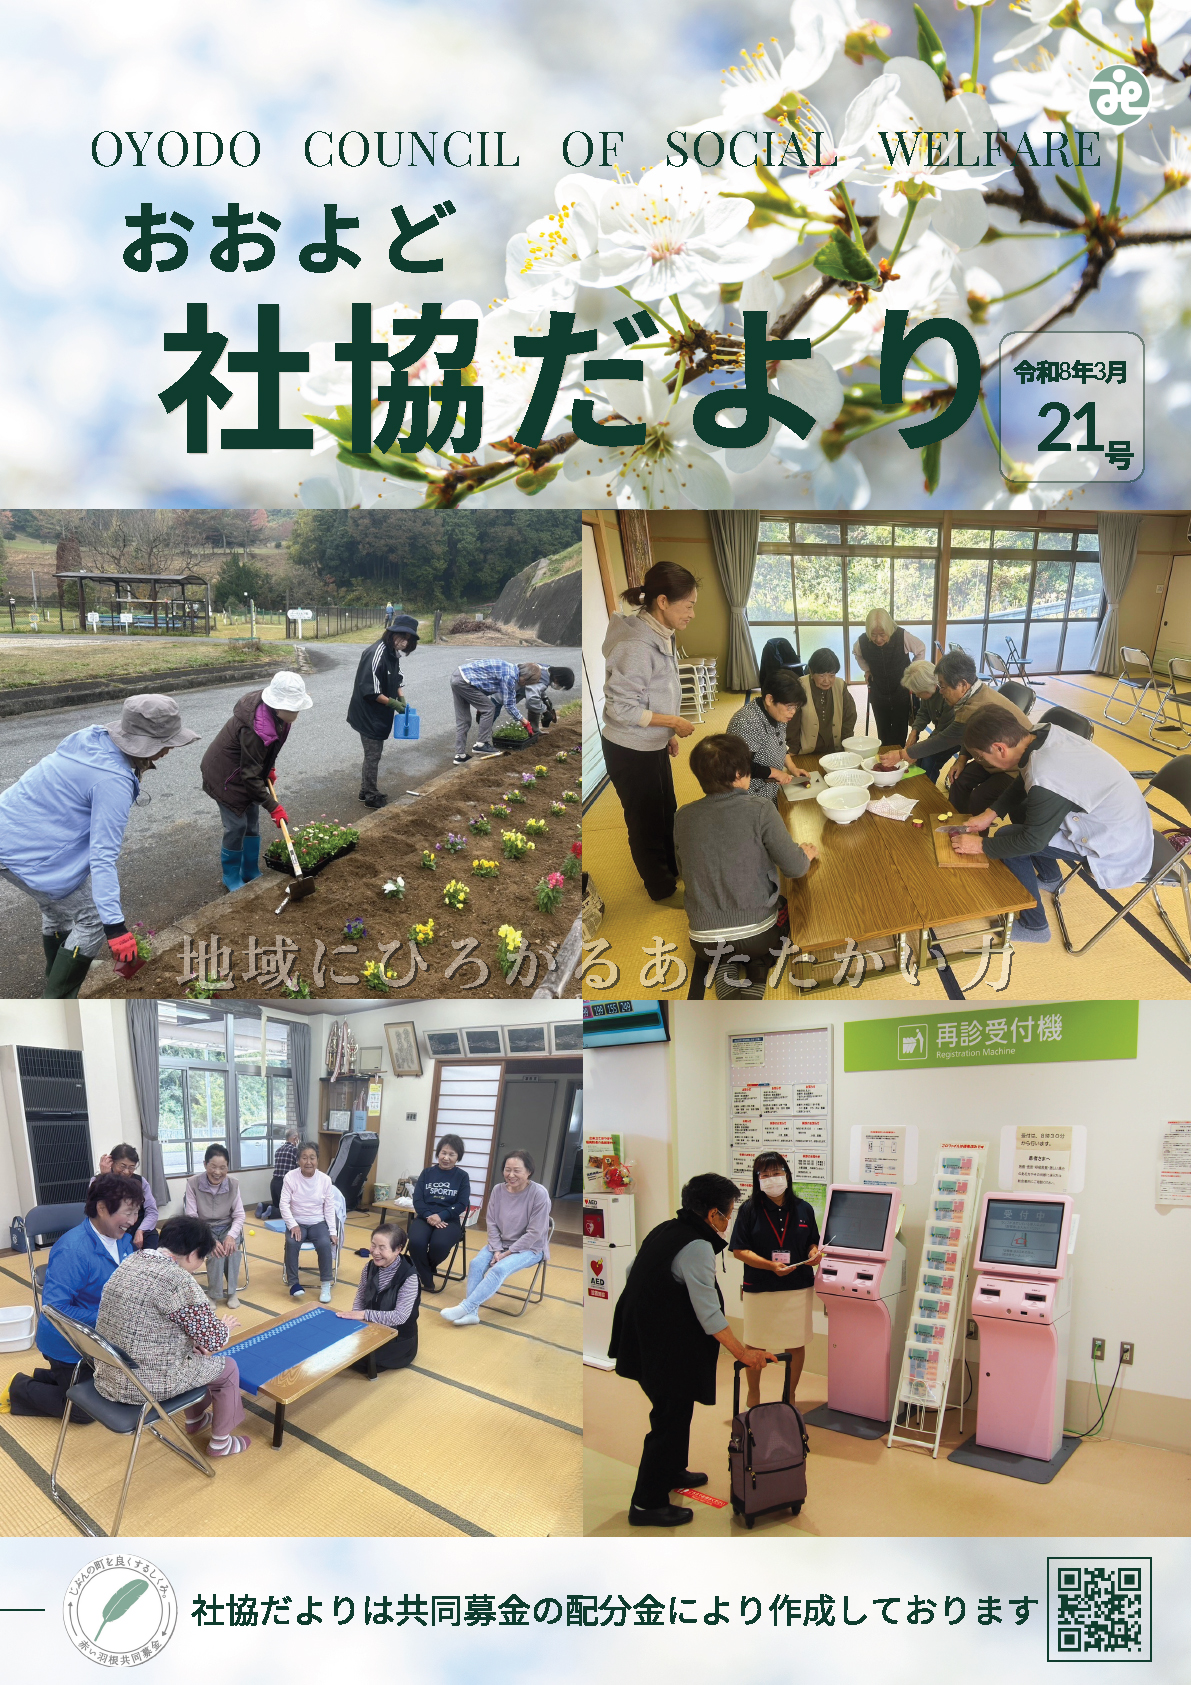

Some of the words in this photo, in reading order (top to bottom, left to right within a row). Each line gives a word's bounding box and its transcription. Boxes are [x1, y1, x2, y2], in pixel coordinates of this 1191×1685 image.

[936, 1013, 1063, 1048] 再診受付機
[936, 1049, 980, 1060] Registration
[982, 1047, 1016, 1056] Machine
[590, 1277, 605, 1286] AED
[69, 1555, 169, 1599] じぶんの町を良くするしくみ。
[78, 1640, 162, 1666] 赤い羽根共同募金
